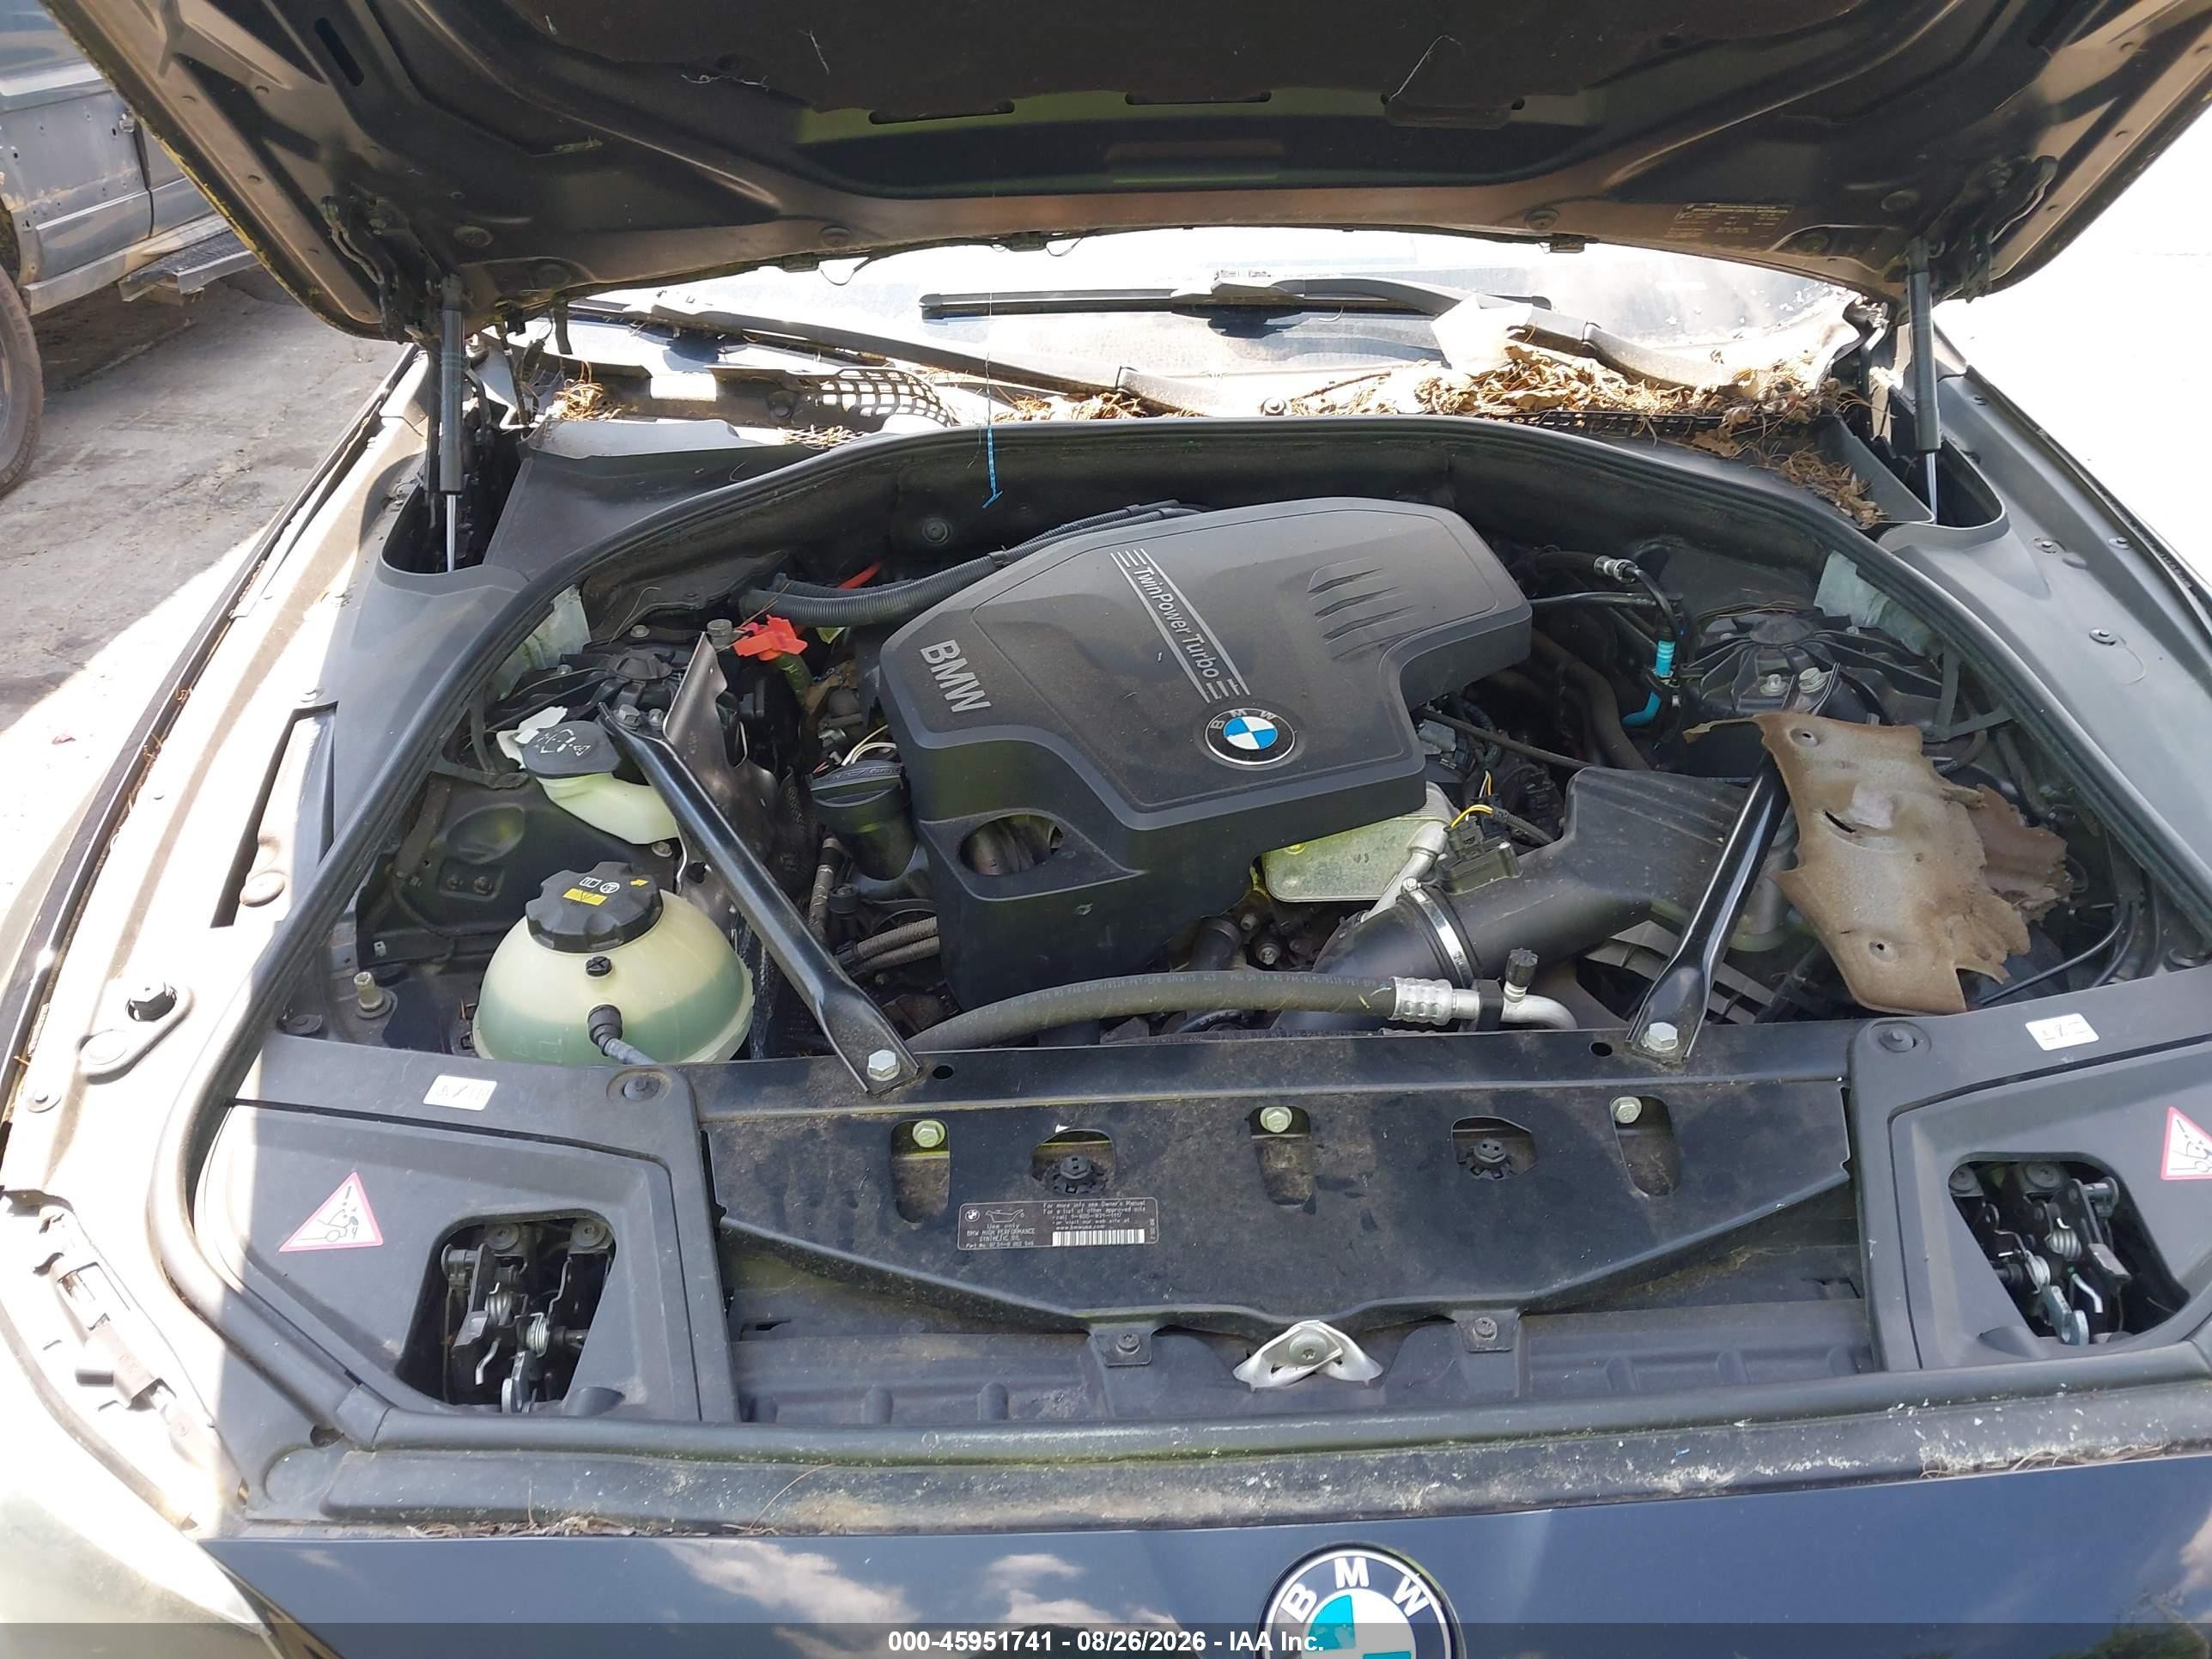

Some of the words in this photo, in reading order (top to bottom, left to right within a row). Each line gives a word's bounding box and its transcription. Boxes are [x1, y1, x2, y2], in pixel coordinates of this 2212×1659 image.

[1133, 566, 1193, 635] TwinPower
[1182, 632, 1220, 679] Turbo
[920, 638, 992, 714] BMW
[1210, 707, 1278, 730] BMW
[1279, 1557, 1431, 1623] BMW
